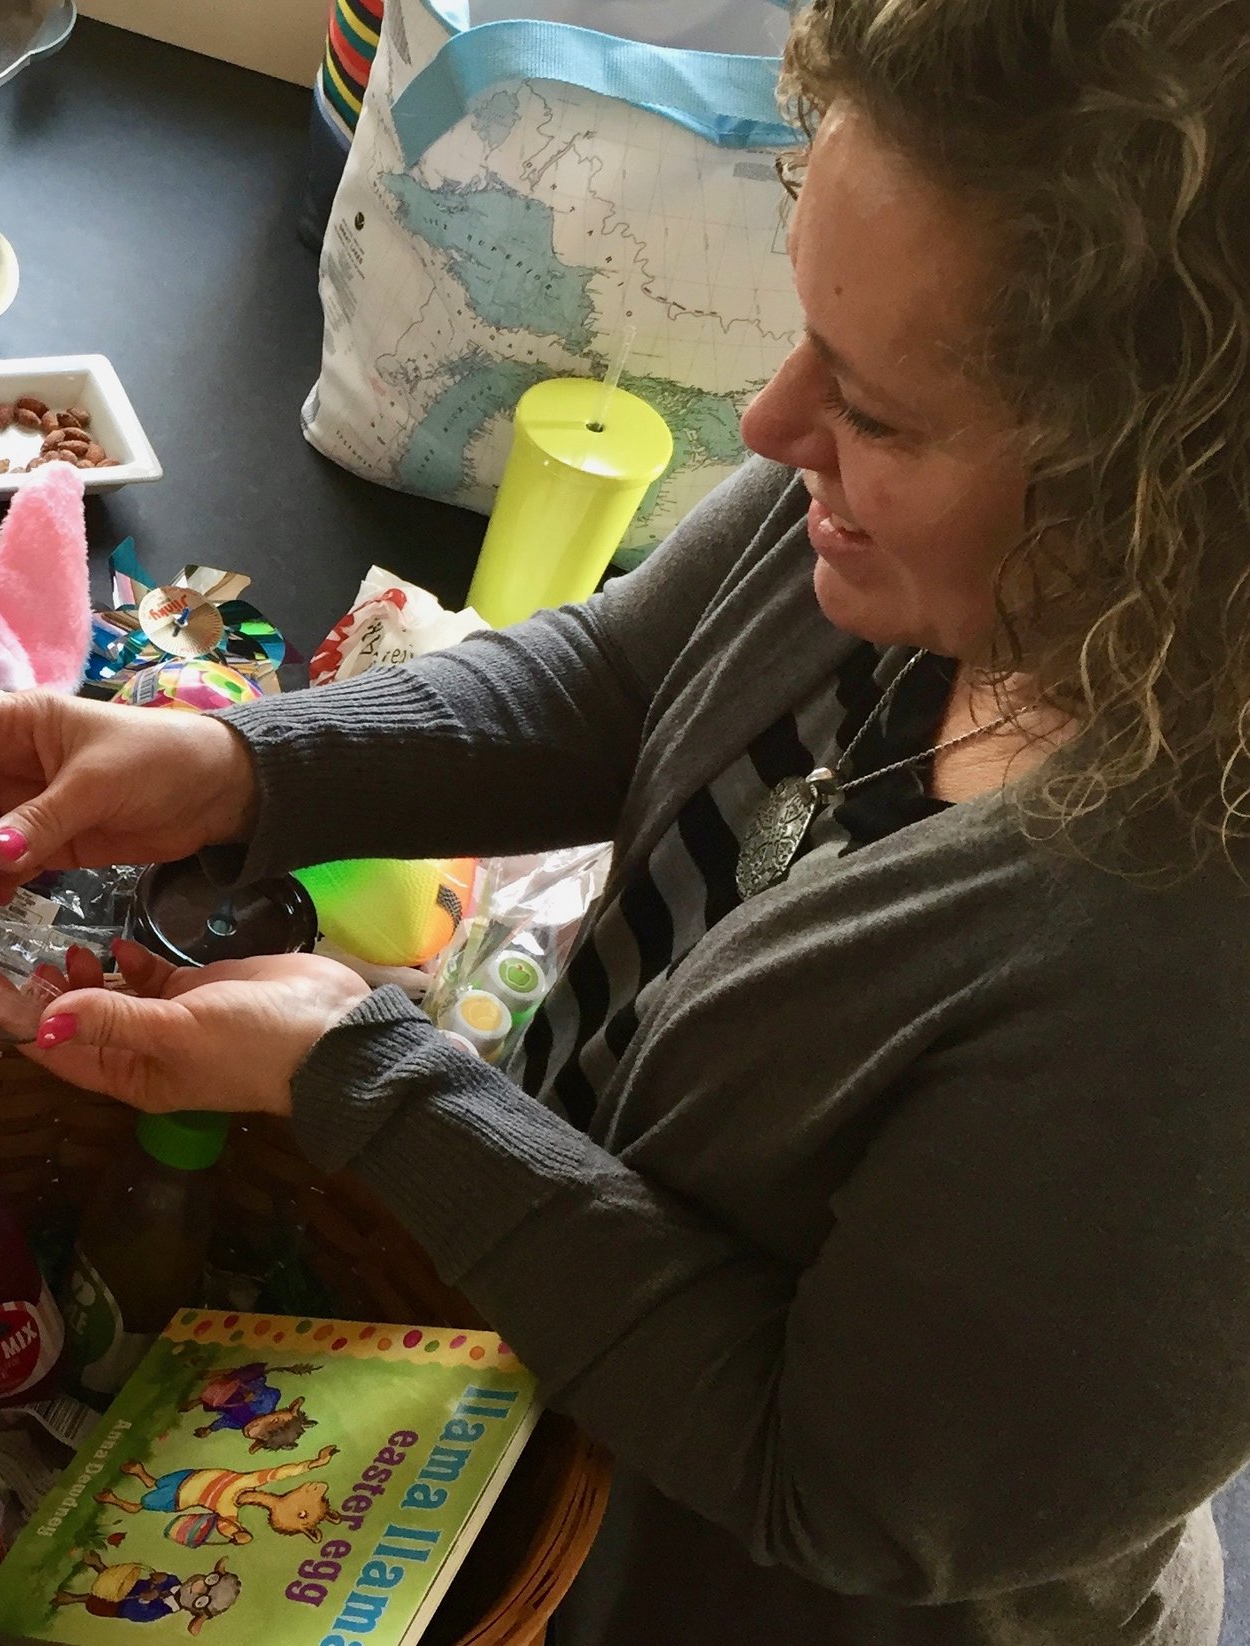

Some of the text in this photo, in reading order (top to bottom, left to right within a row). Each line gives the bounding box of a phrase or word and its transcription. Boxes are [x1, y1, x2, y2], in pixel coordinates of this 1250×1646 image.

[1, 1321, 38, 1360] MIX
[36, 1419, 132, 1537] Anna Dewdney
[400, 1385, 519, 1510] llama
[285, 1430, 419, 1607] easter egg
